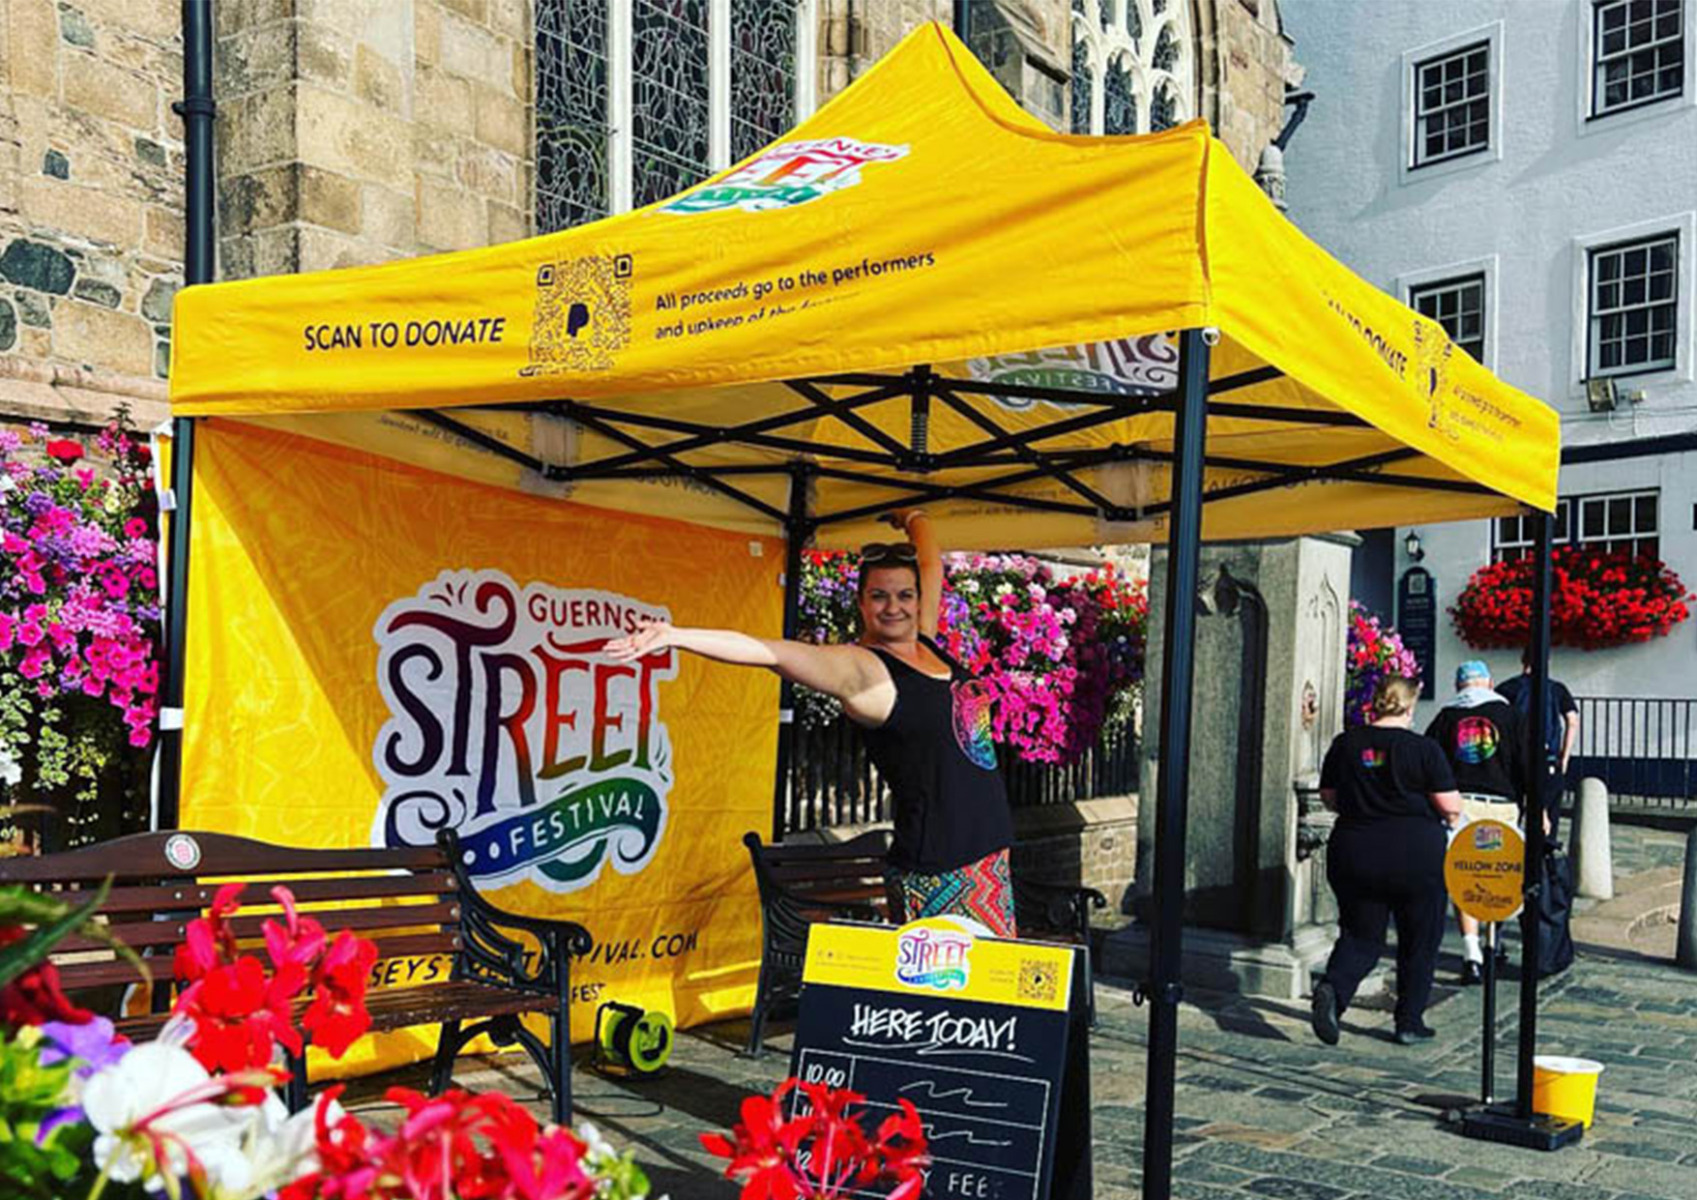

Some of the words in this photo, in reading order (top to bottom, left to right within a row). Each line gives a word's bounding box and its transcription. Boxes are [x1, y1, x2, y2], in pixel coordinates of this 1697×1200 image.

[656, 292, 676, 311] All
[681, 281, 749, 311] proceeds
[753, 281, 773, 300] go
[778, 276, 795, 292] to
[799, 270, 828, 288] the
[832, 252, 935, 286] performers
[304, 325, 362, 350] SCAN
[369, 322, 399, 348] TO
[405, 317, 506, 346] DONATE
[655, 319, 684, 340] and
[528, 593, 665, 634] GUERNS
[386, 582, 671, 820] STREET
[509, 791, 645, 856] FESTIVAL
[1454, 860, 1492, 872] YELLOW
[898, 928, 971, 972] STREET
[851, 1003, 924, 1041] HERE
[926, 1011, 1017, 1051] TODAY!
